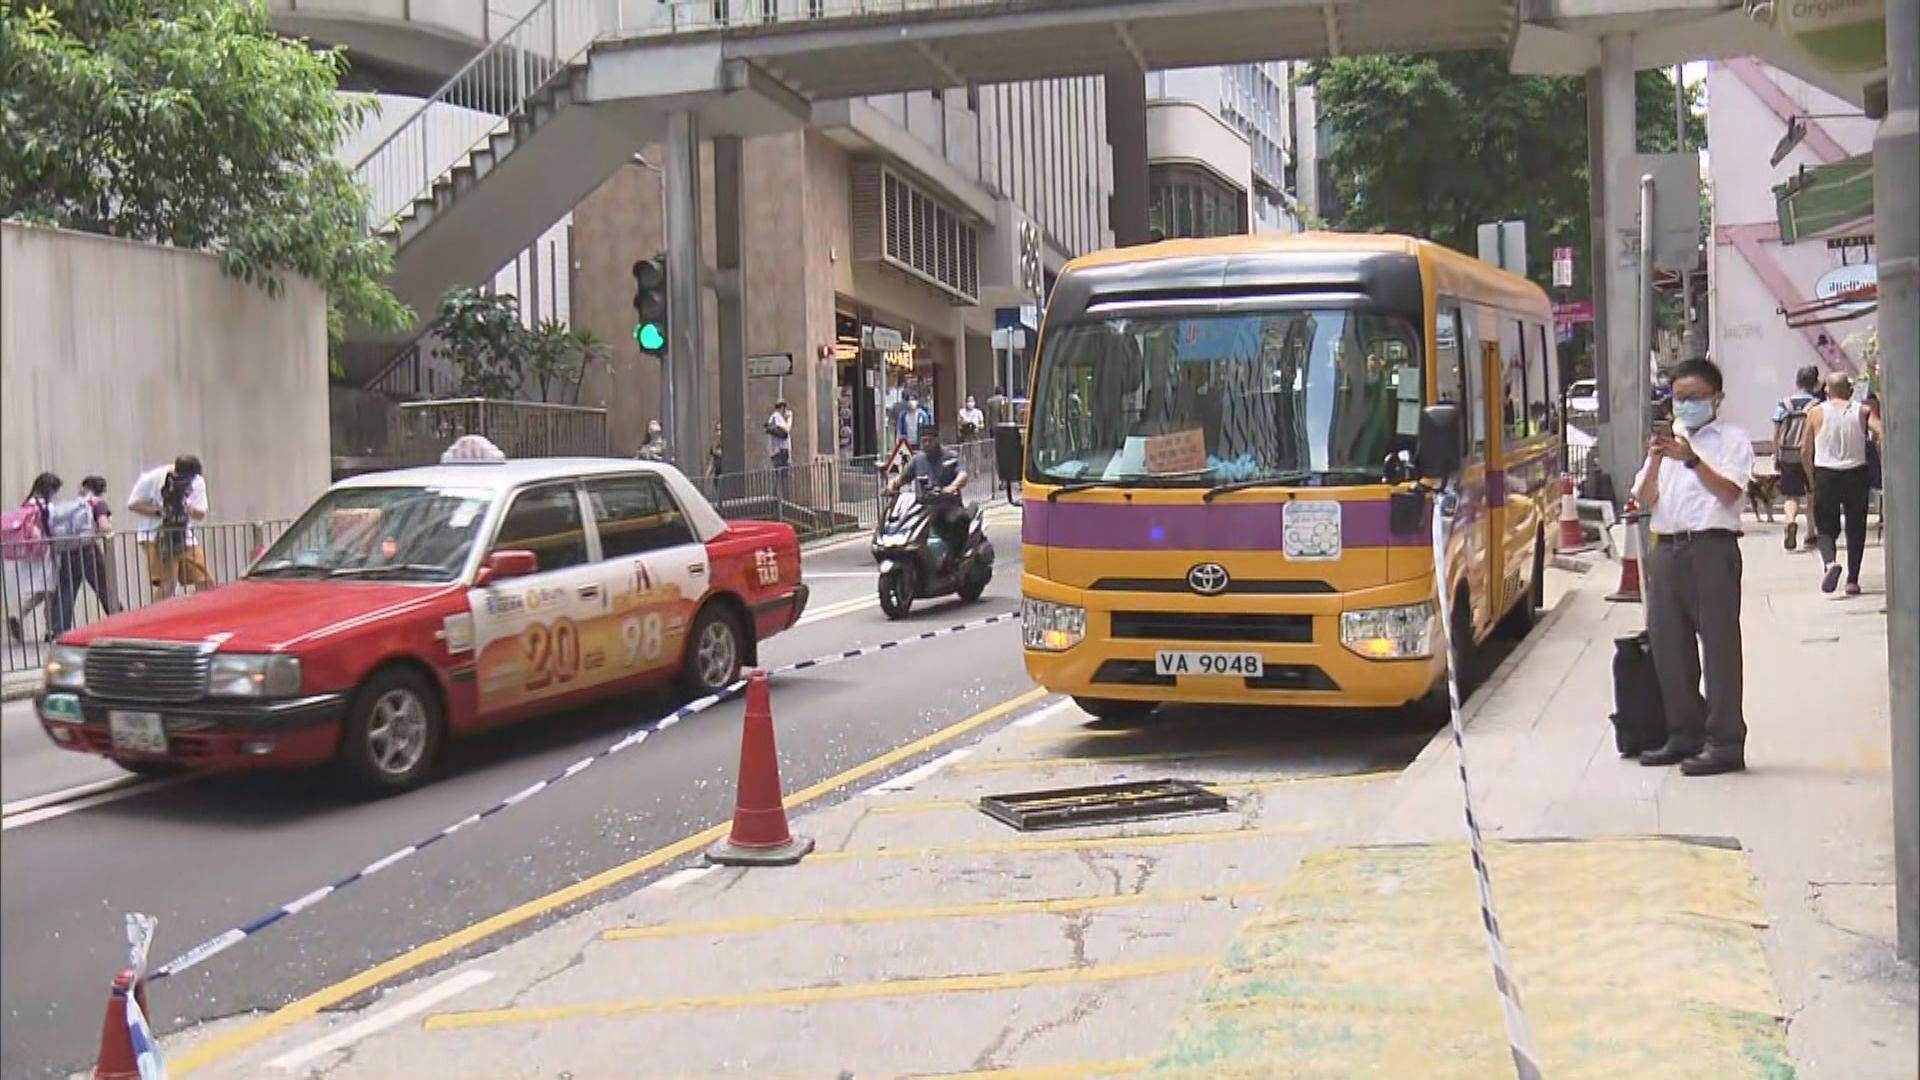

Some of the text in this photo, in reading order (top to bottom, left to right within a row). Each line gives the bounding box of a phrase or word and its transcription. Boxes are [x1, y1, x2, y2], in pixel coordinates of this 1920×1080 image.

[755, 546, 777, 566] 的士
[756, 566, 779, 585] TAXI
[621, 611, 664, 669] 98
[526, 615, 580, 692] 20
[1161, 653, 1258, 674] VA 9048
